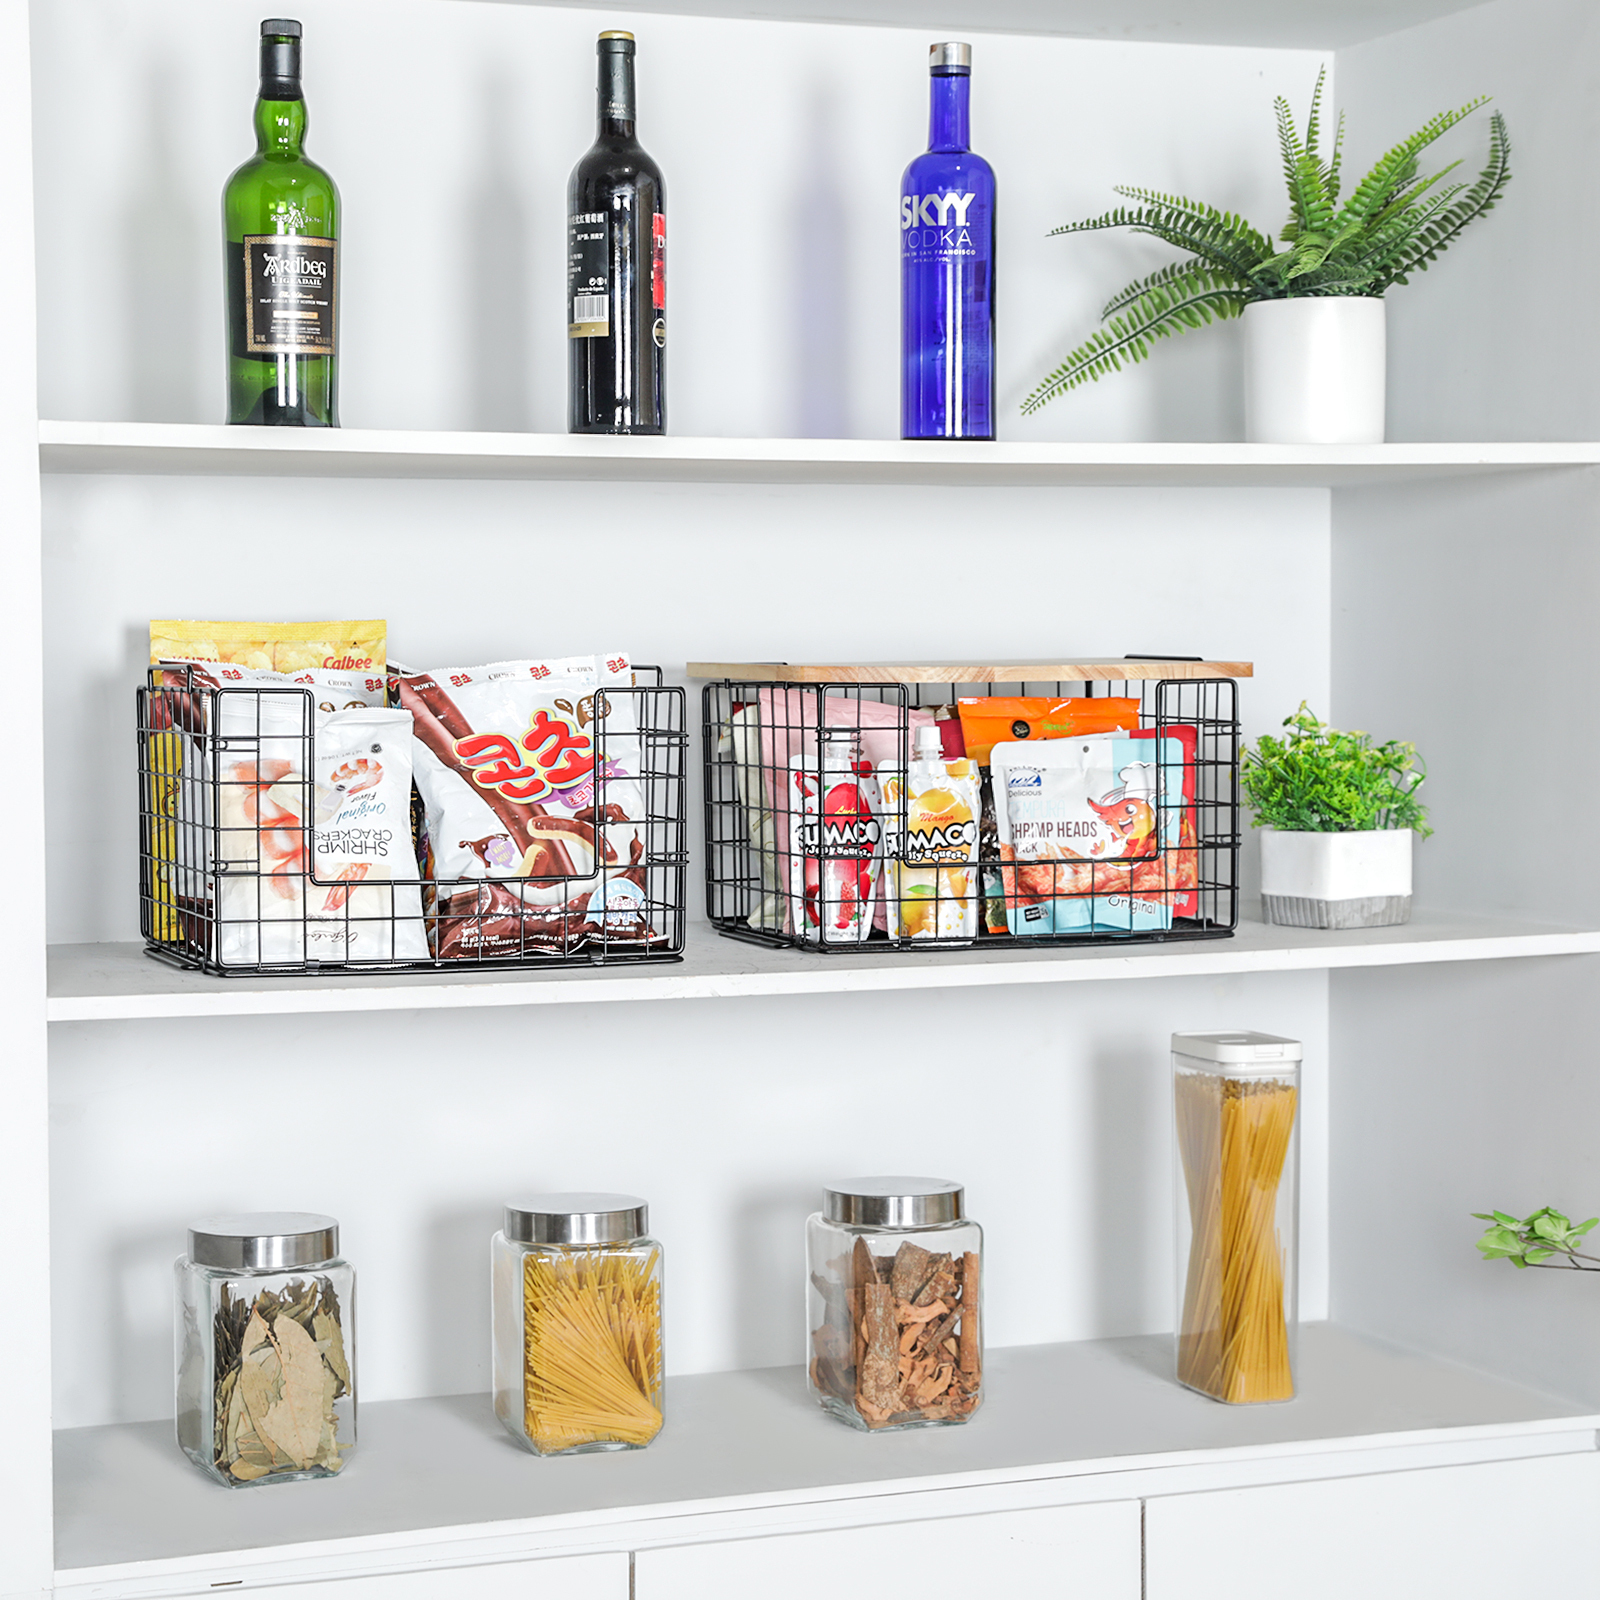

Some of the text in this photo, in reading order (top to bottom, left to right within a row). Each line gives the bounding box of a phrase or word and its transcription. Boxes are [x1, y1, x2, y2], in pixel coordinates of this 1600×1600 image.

[901, 228, 973, 249] VODKA
[934, 248, 976, 256] FRANCISCO
[323, 656, 372, 670] Calbee
[411, 681, 436, 692] ROWN
[454, 710, 605, 799] 콘초
[351, 791, 377, 803] Flavor
[1008, 790, 1042, 798] Delicious
[336, 800, 387, 825] Original
[920, 812, 954, 824] Mango
[314, 828, 393, 842] CRACKERS
[1057, 821, 1098, 838] HEADS
[317, 840, 389, 857] SHRIMP
[924, 849, 968, 863] Squeeze
[1108, 895, 1157, 915] Original
